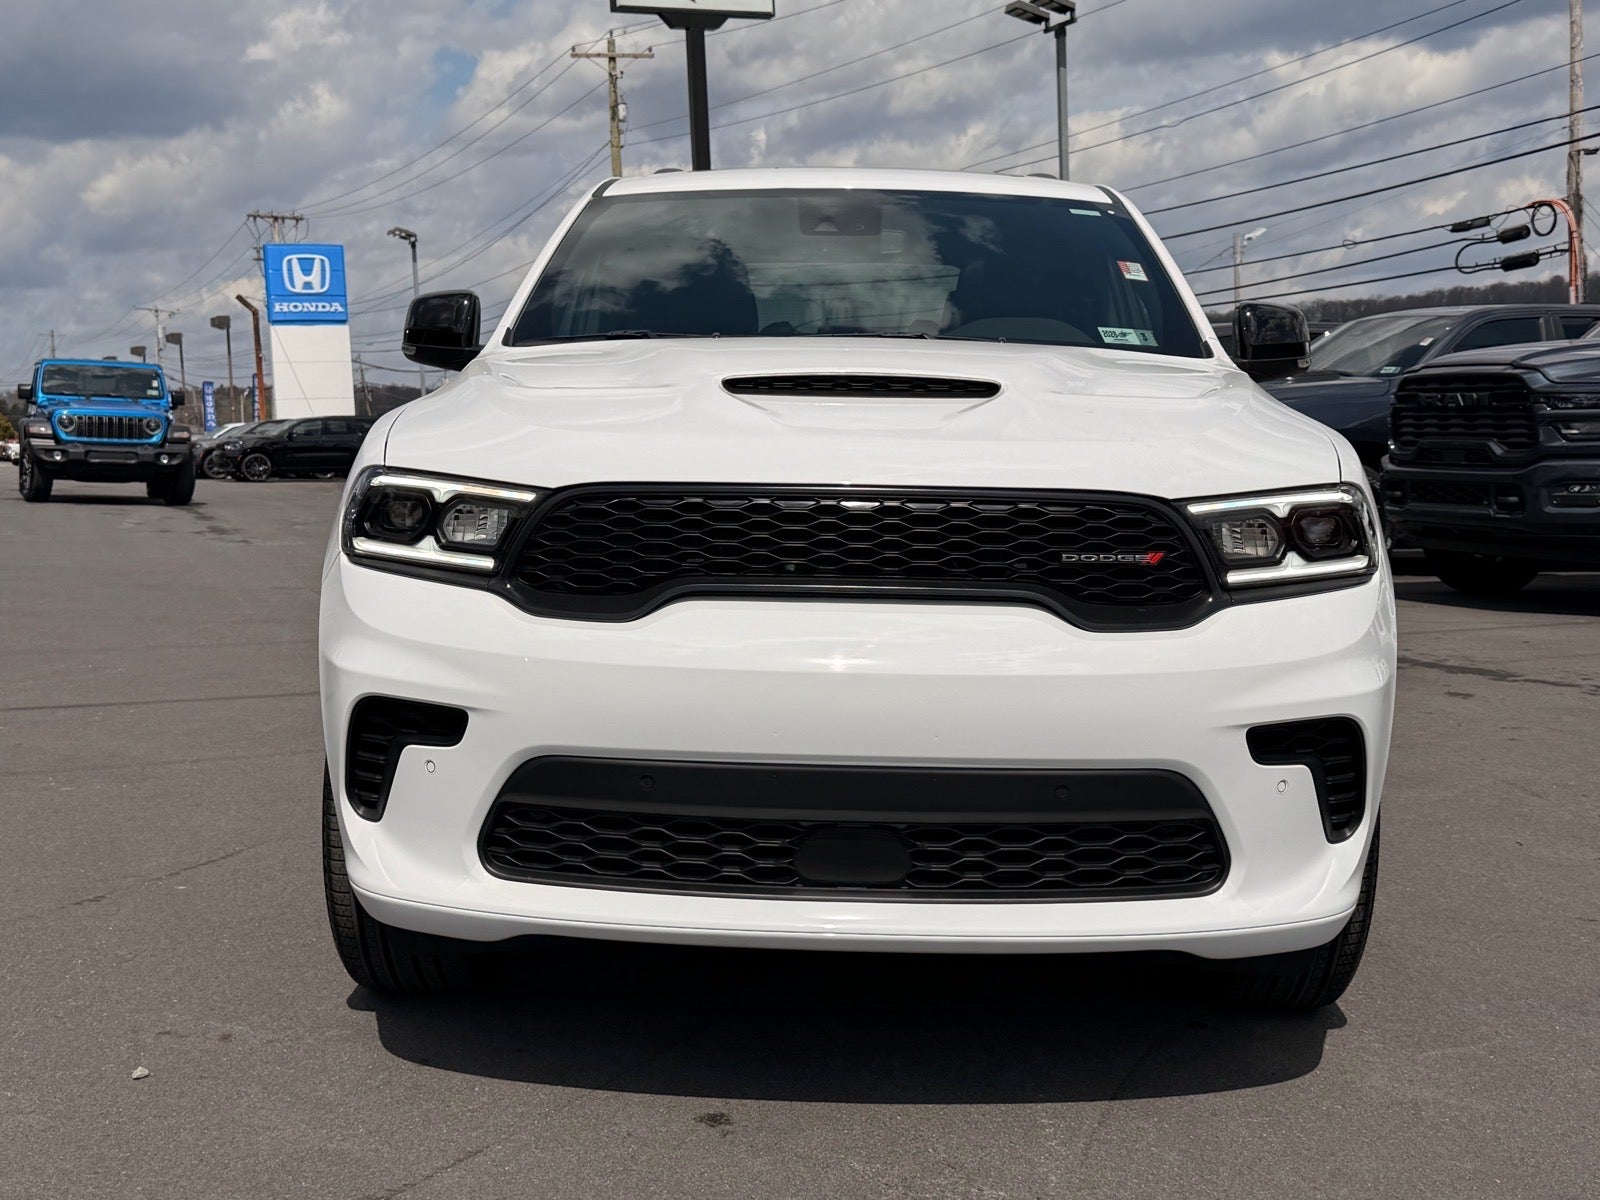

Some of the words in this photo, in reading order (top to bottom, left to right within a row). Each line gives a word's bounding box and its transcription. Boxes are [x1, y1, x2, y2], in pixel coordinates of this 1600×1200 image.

[273, 302, 345, 313] HONDA
[1421, 392, 1491, 407] RAM
[205, 395, 216, 427] HONDA
[1062, 554, 1151, 562] DODGE
